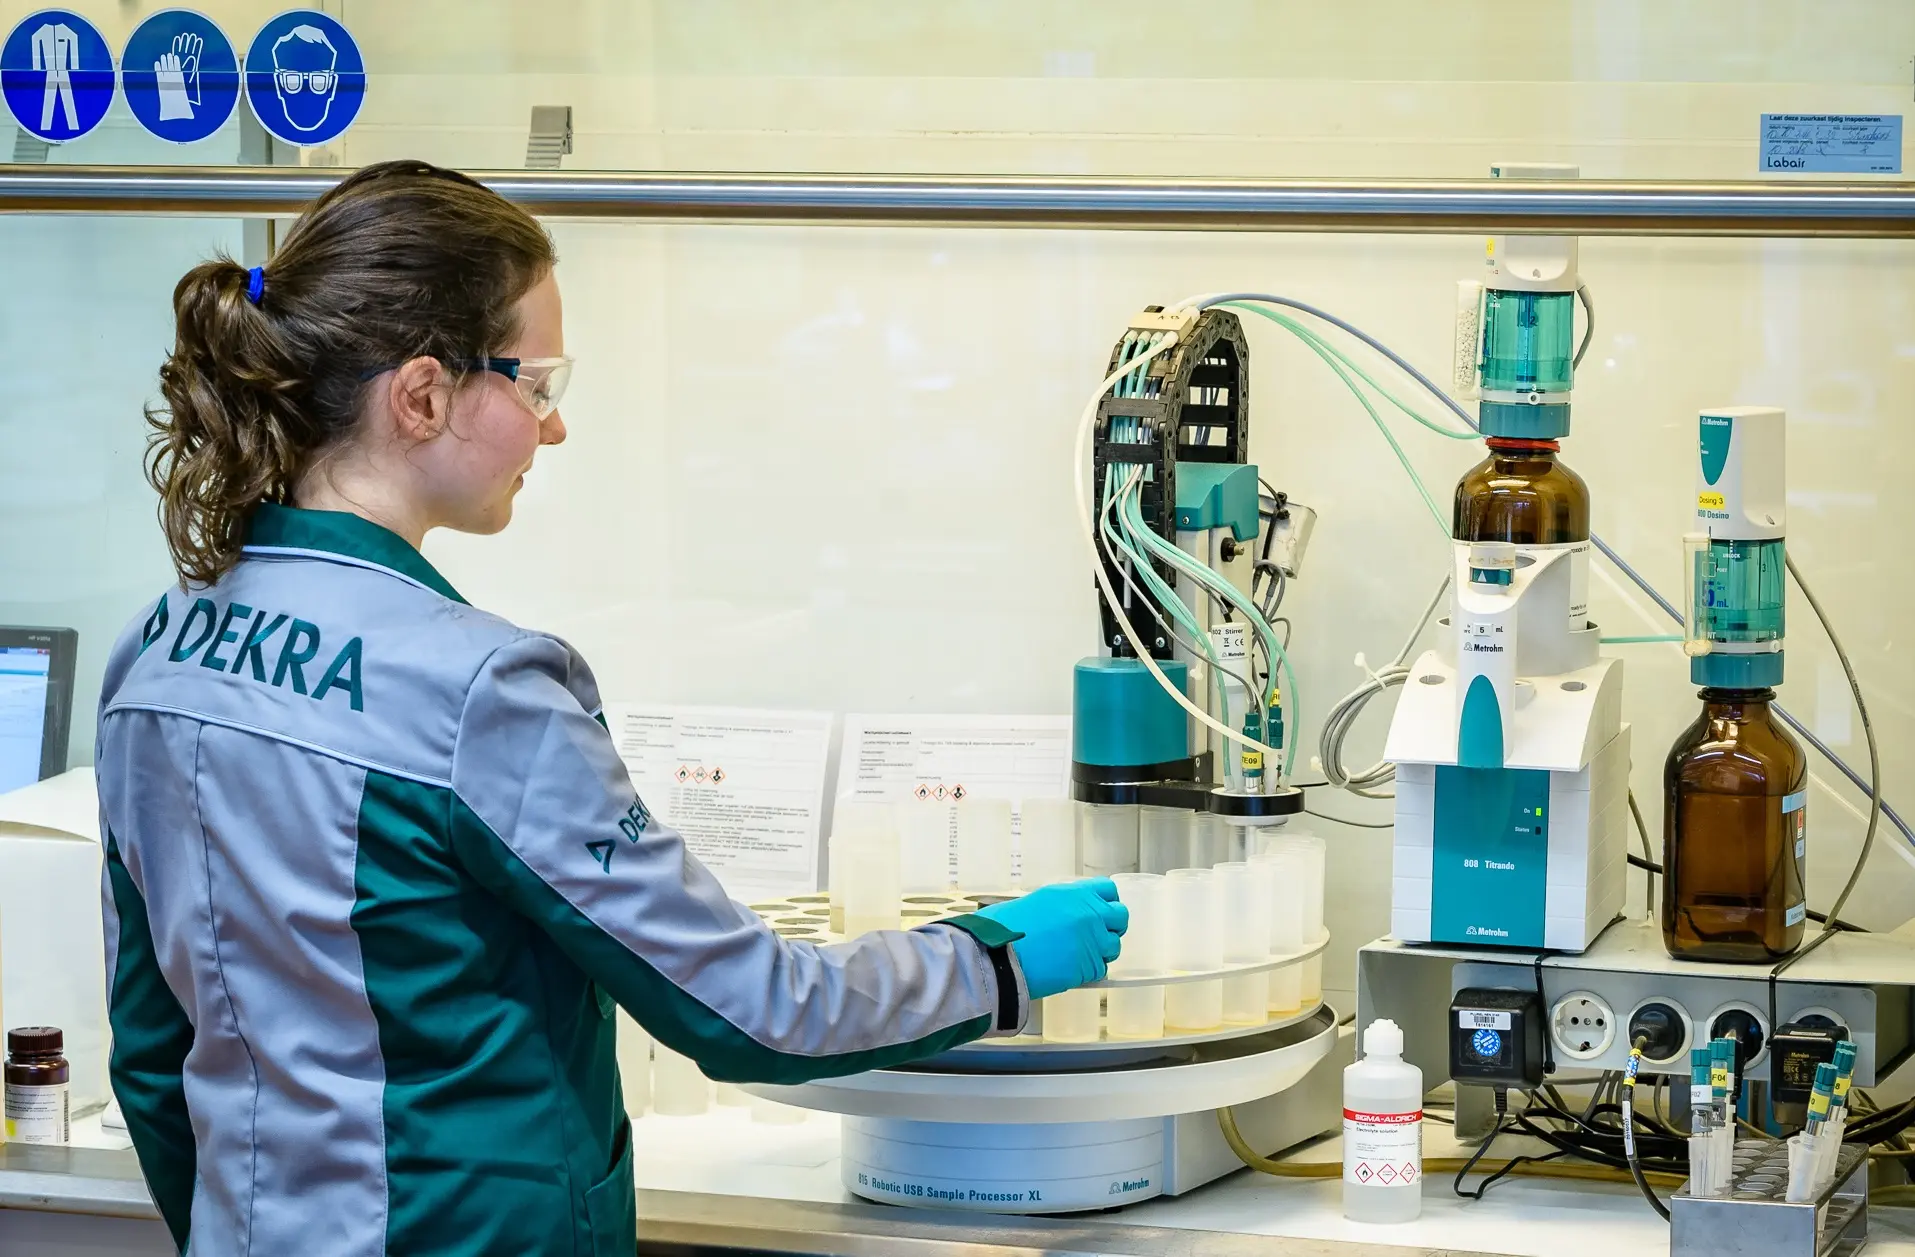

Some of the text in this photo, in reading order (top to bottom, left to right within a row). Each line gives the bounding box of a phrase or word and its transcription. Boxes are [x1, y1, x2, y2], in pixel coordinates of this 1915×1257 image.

[1767, 157, 1805, 168] Labair
[1707, 510, 1730, 519] Dosino
[1479, 626, 1485, 634] 5
[1473, 643, 1504, 653] Metrohm
[168, 598, 364, 713] DEKRA
[1463, 859, 1515, 870] 808 Titrando
[1477, 927, 1509, 937] Metrohm
[1354, 1113, 1417, 1123] SIGMA-ALDRICH
[858, 1172, 1042, 1202] 815 Robotic USB Sample Processor XL
[1122, 1177, 1150, 1193] Metrohm
